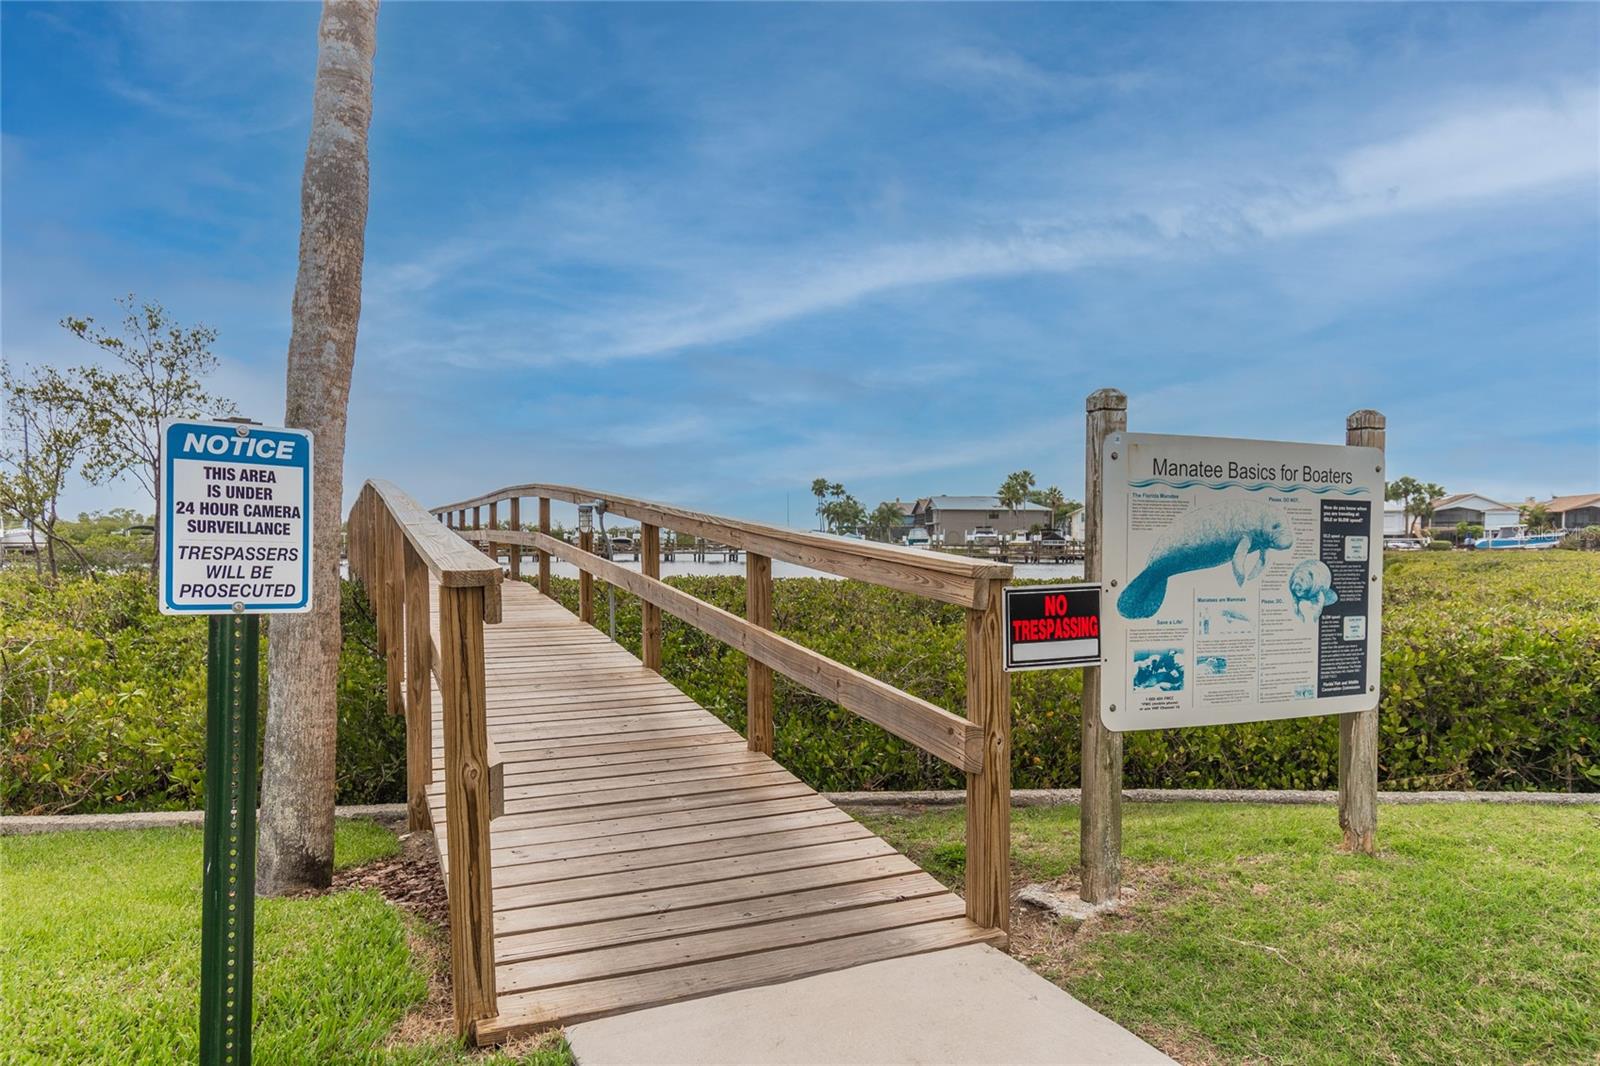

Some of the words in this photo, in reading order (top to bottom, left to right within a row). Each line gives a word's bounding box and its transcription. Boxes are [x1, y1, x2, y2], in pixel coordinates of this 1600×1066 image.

[183, 433, 296, 460] NOTICE
[203, 466, 236, 481] THIS
[239, 469, 276, 483] AREA
[1152, 458, 1222, 478] Manatee
[1228, 462, 1276, 481] Basics
[1280, 464, 1298, 482] for
[1302, 466, 1353, 485] Boaters
[207, 485, 221, 498] IS
[226, 486, 272, 500] UNDER
[176, 501, 194, 515] 24
[200, 502, 238, 516] HOUR
[244, 504, 300, 519] CAMERA
[187, 520, 291, 536] SURVEILLANCE
[178, 546, 299, 561] TRESPASSERS
[206, 565, 245, 579] WILL
[250, 566, 273, 579] BE
[179, 584, 296, 598] PROSECUTED
[1044, 594, 1068, 616] NO
[1012, 616, 1098, 640] TRESPASSING
